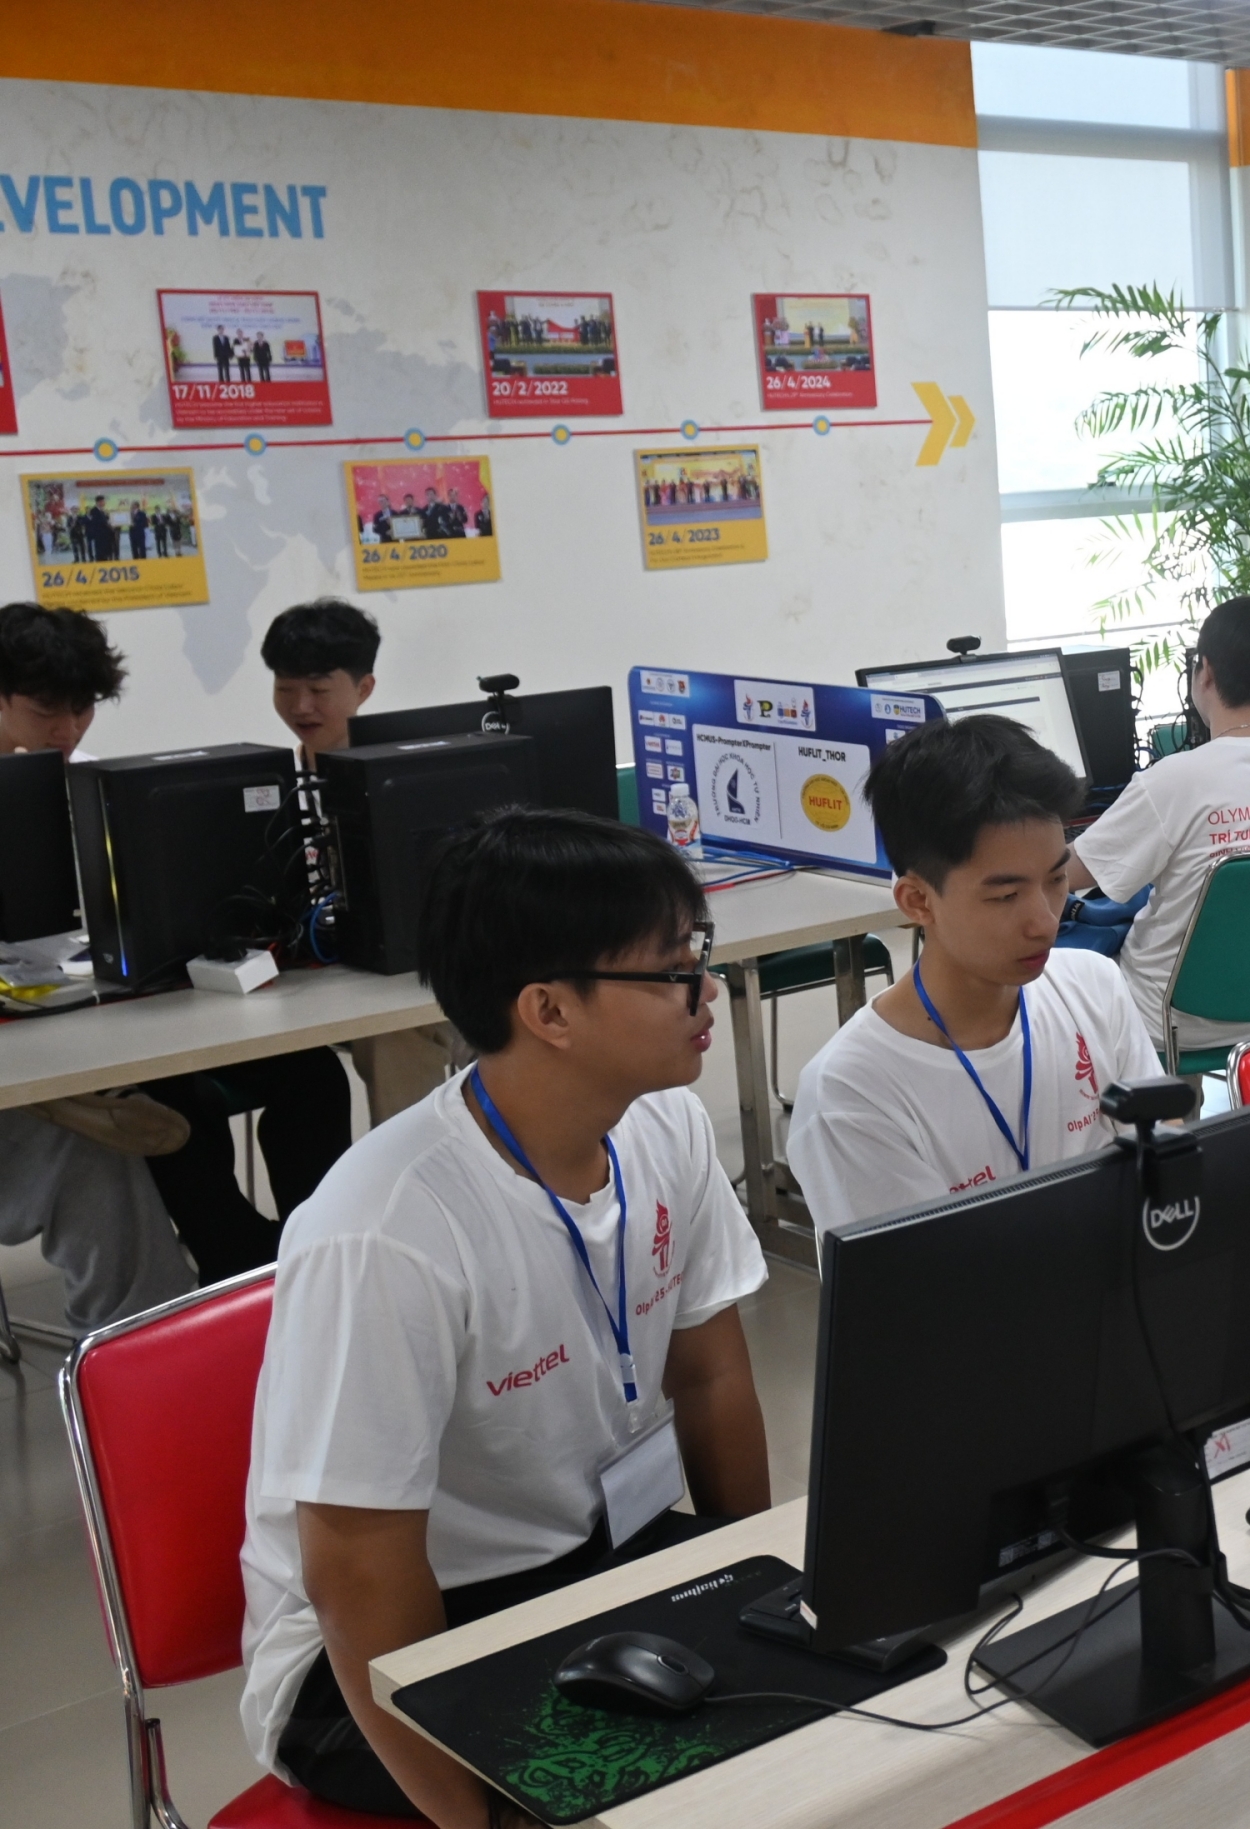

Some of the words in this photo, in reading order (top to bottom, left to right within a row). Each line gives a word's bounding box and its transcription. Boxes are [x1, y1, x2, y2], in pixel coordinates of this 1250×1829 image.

[0, 173, 327, 239] VELOPMENT
[492, 380, 568, 397] 20/2/2022
[766, 375, 831, 390] 26/4/2024
[172, 384, 255, 400] 17/11/2018
[648, 528, 720, 546] 26/4/2023
[362, 544, 448, 563] 26/4/2020
[42, 566, 140, 588] 26/4/2015
[900, 705, 921, 715] HUTECH
[798, 746, 846, 762] HUFLIT_THOR
[808, 795, 842, 811] HUFLIT
[1209, 830, 1231, 845] TRÍ
[1150, 1199, 1195, 1229] DELL
